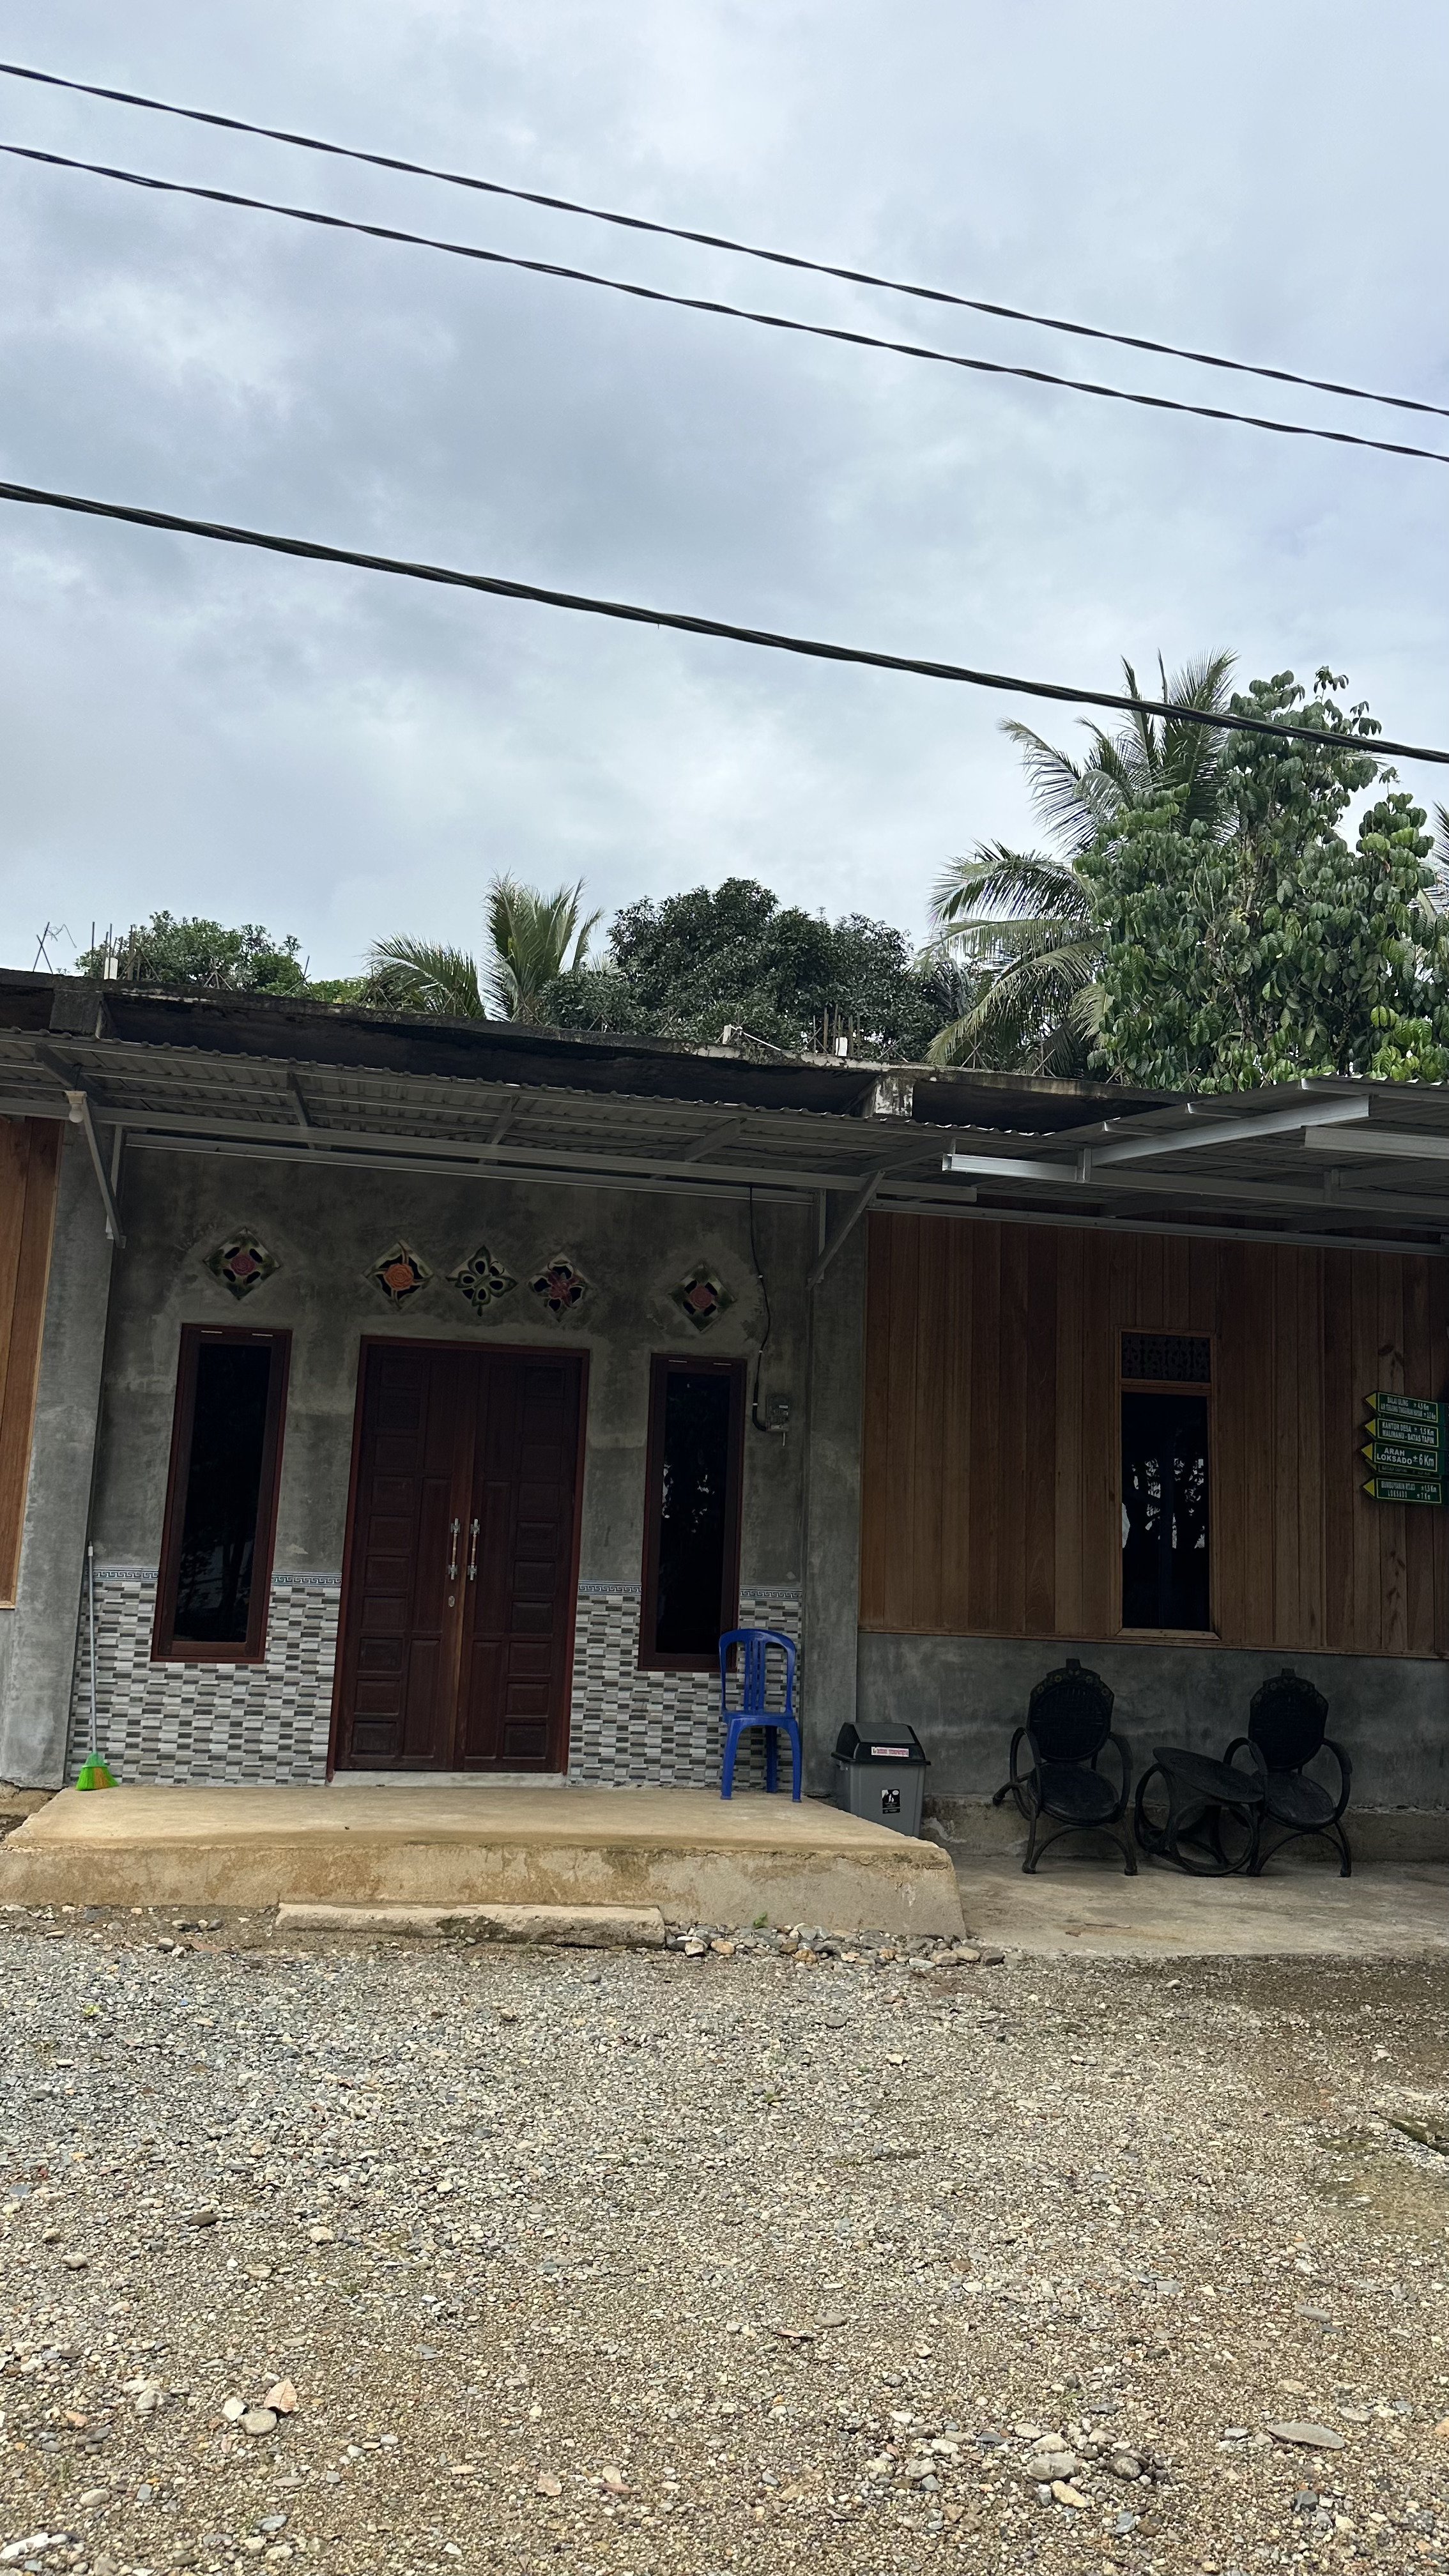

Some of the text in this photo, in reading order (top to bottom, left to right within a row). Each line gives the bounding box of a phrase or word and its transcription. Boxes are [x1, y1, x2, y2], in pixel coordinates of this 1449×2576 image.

[1382, 1422, 1399, 1430] KANTOR
[1400, 1424, 1411, 1432] DESA
[1407, 1434, 1421, 1442] BATAS
[1384, 1448, 1405, 1456] ARAH
[1377, 1453, 1412, 1464] LOKSADO
[1424, 1455, 1434, 1467] Km
